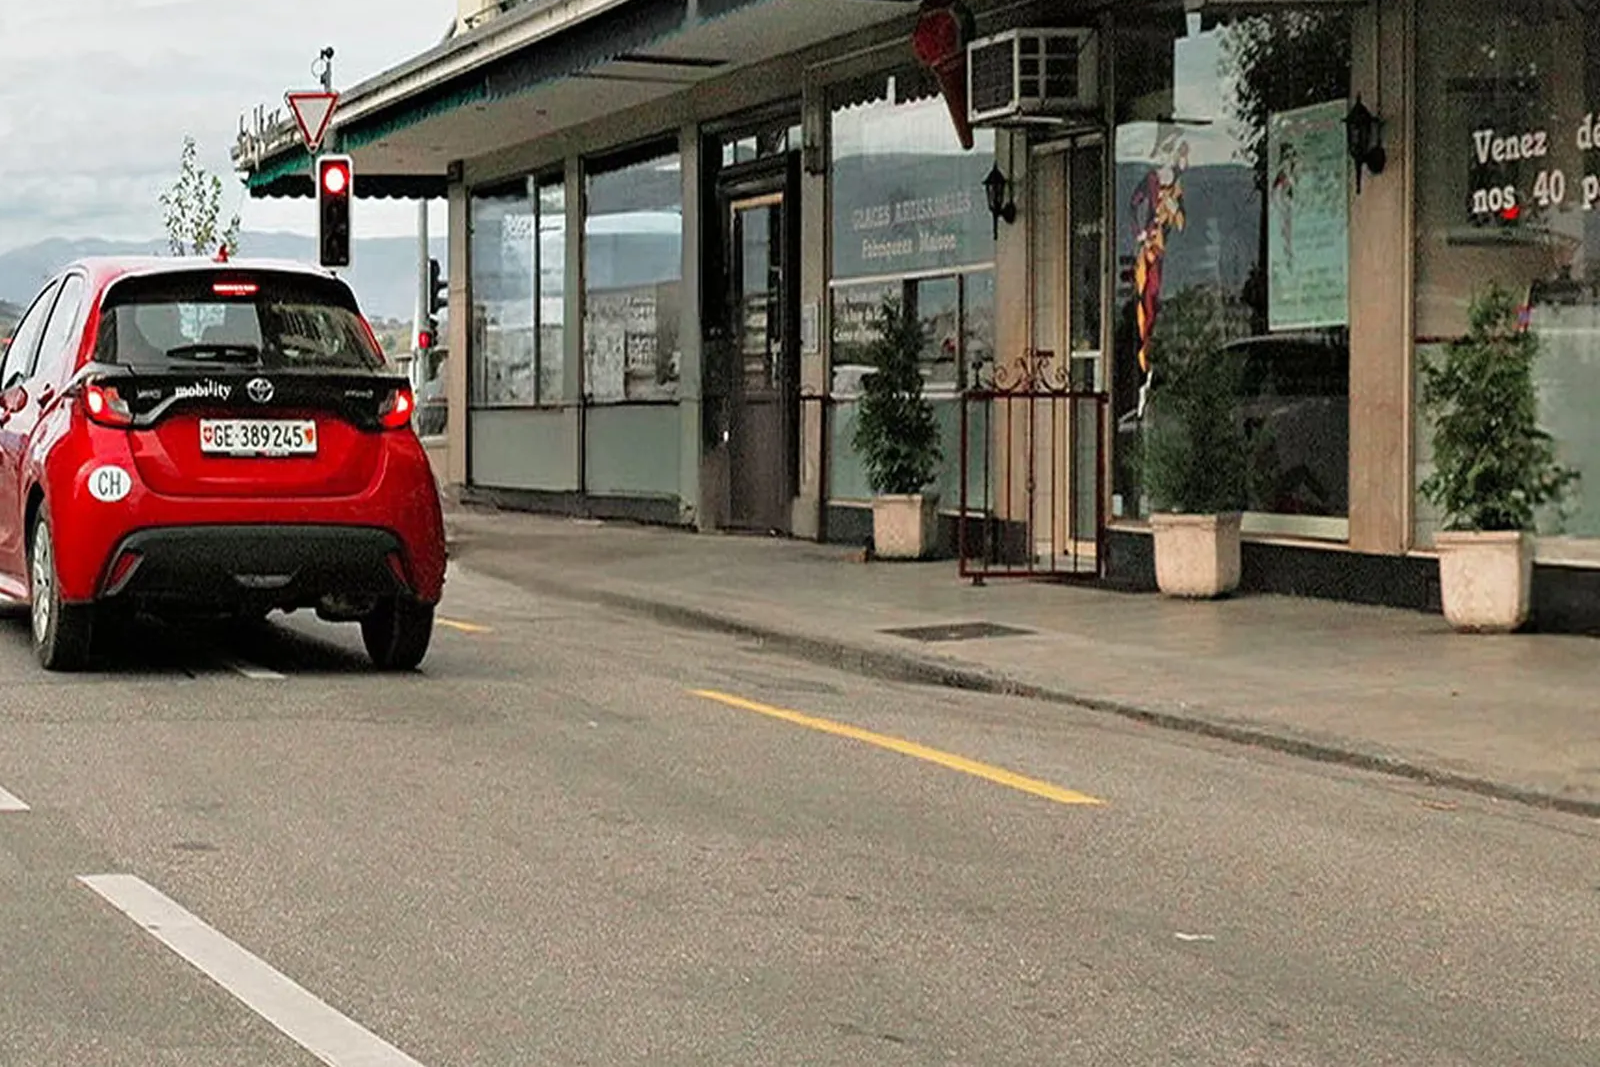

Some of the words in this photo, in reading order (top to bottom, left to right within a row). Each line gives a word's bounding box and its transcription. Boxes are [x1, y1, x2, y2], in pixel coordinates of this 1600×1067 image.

[1473, 129, 1547, 164] Venez
[1473, 185, 1516, 213] nos
[1533, 170, 1565, 205] 40
[174, 379, 231, 400] mobility
[98, 470, 121, 496] CH
